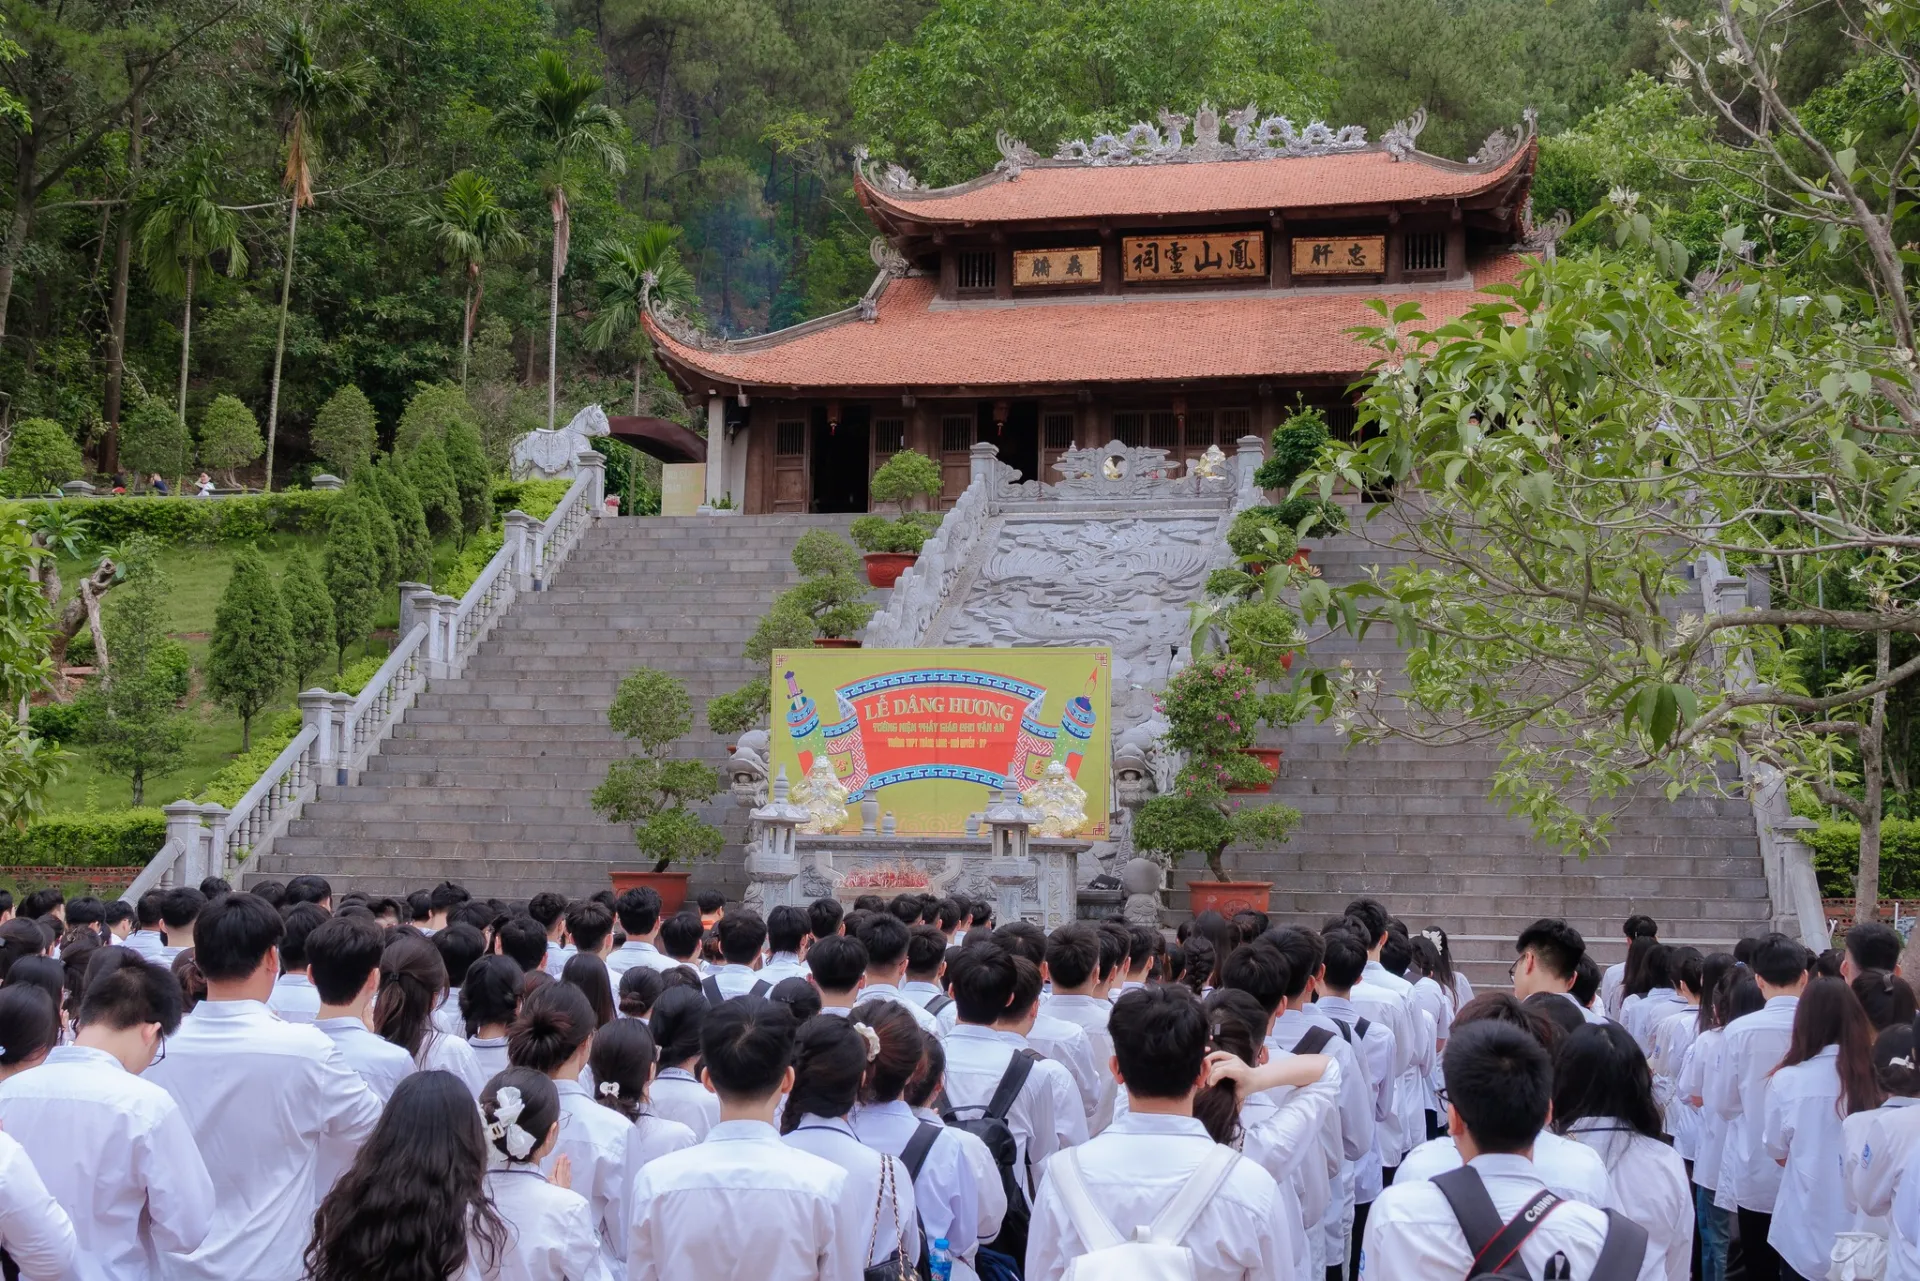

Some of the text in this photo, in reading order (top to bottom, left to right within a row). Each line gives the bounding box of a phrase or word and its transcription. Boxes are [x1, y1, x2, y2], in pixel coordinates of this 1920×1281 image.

[864, 694, 1014, 721] LỄ DÂNG HƯƠNG
[993, 722, 1005, 732] AN
[1524, 1194, 1557, 1222] Canon
